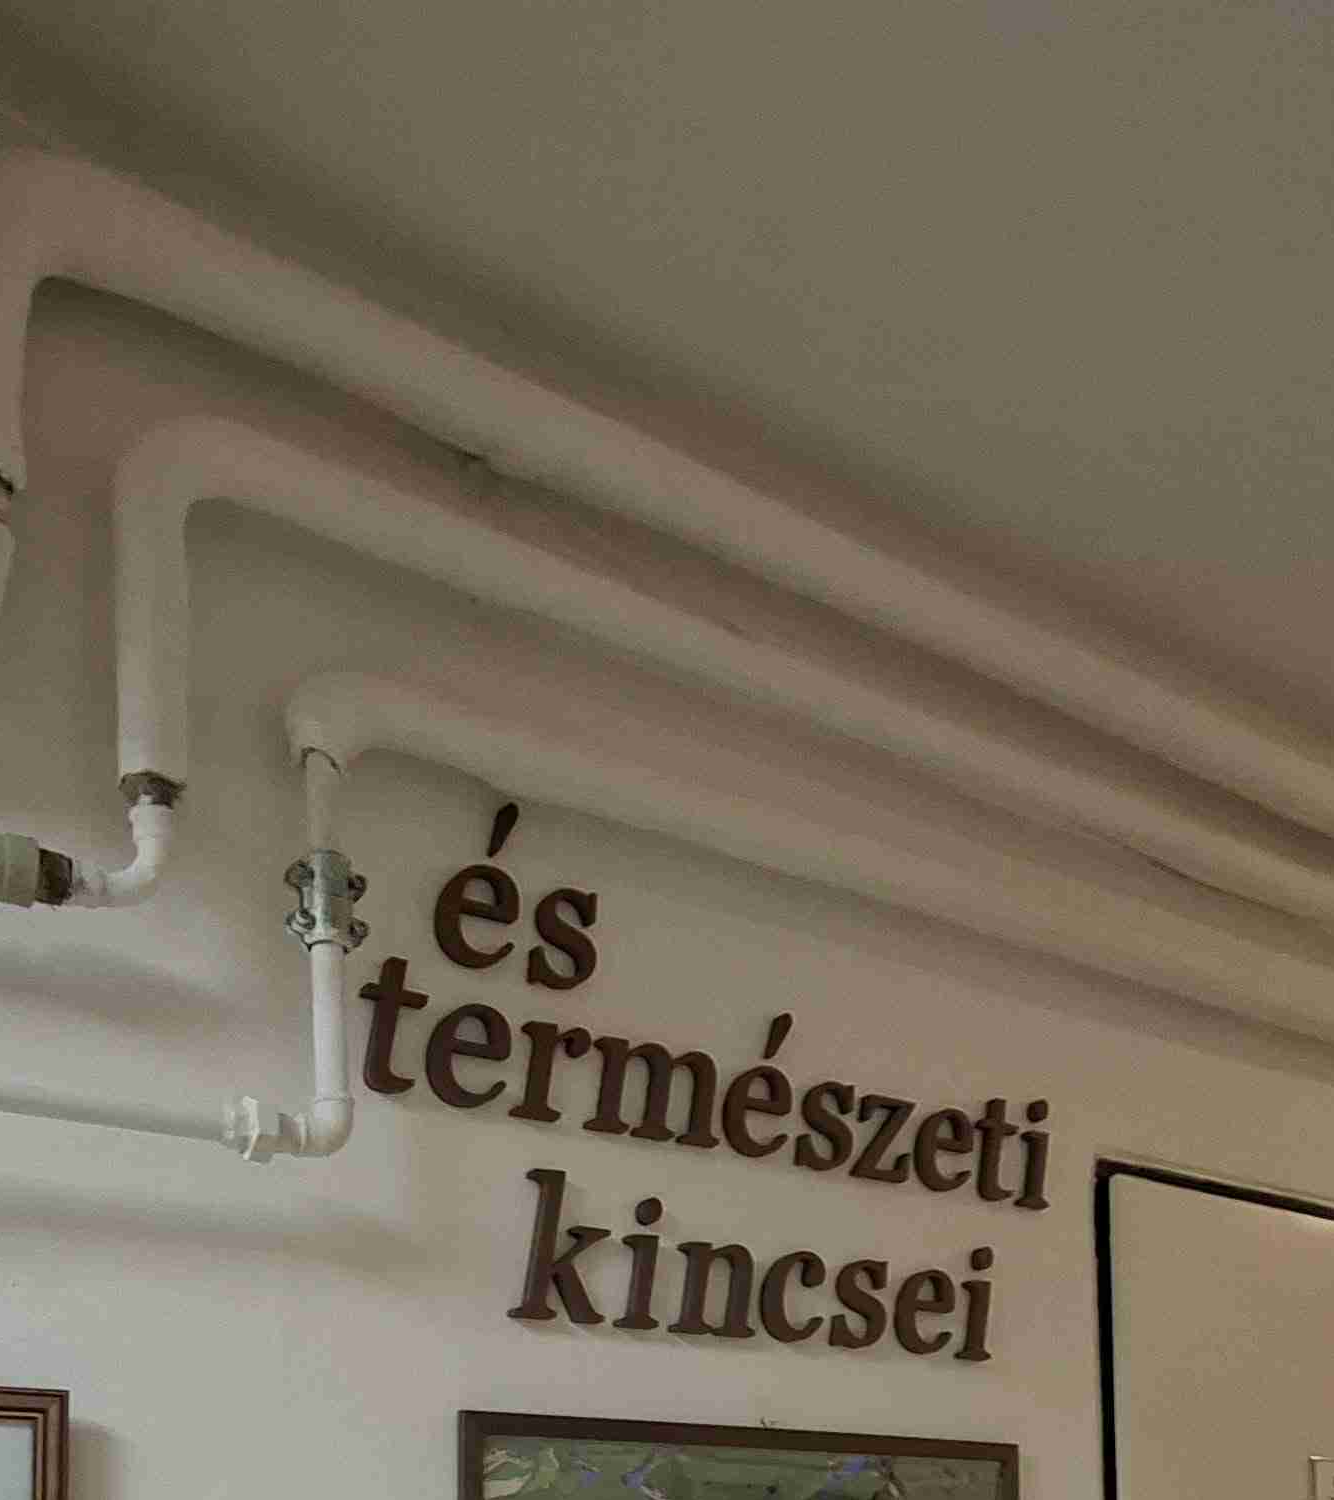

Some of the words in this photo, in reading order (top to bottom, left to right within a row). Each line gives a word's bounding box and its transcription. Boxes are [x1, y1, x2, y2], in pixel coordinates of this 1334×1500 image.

[434, 802, 598, 991] és
[358, 955, 1051, 1210] természeti
[507, 1168, 994, 1362] kincsei
